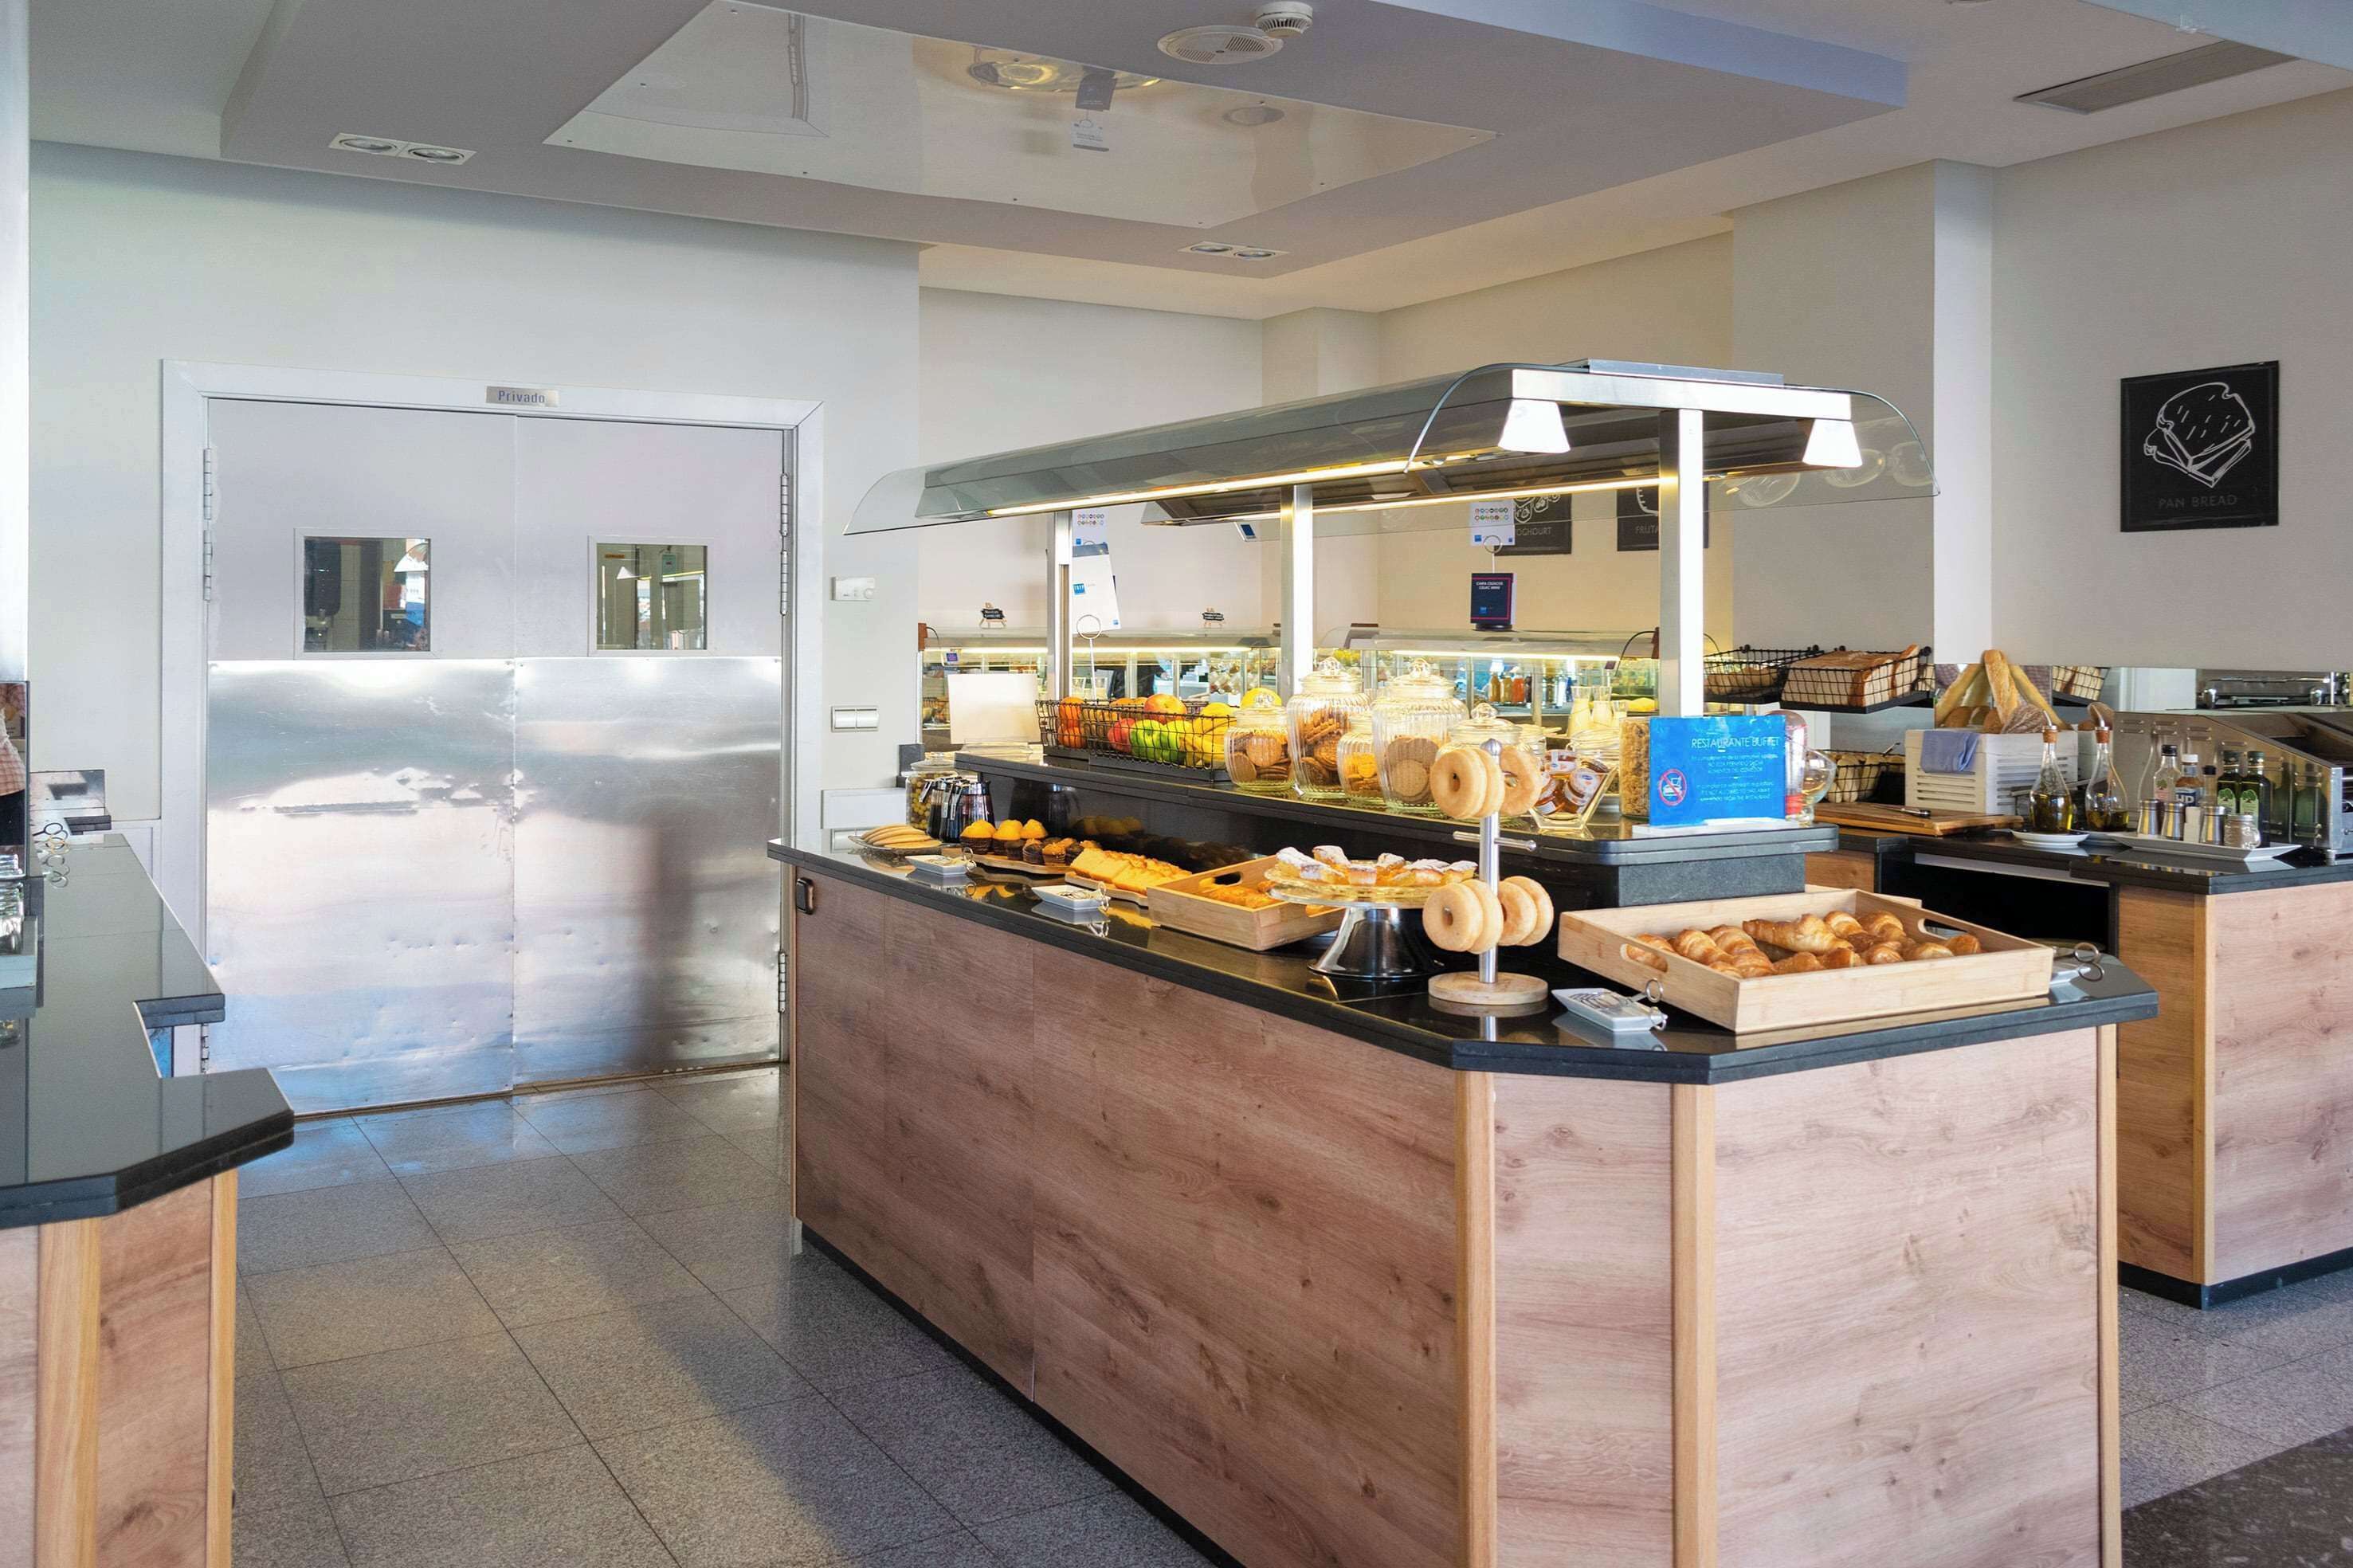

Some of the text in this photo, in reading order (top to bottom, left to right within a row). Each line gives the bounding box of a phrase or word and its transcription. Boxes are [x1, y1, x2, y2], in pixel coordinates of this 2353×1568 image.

[498, 390, 545, 403] Privado
[2159, 495, 2237, 509] PAN BREAD
[1516, 527, 1552, 536] OGHOURT
[1691, 737, 1751, 749] RESTAURANTE
